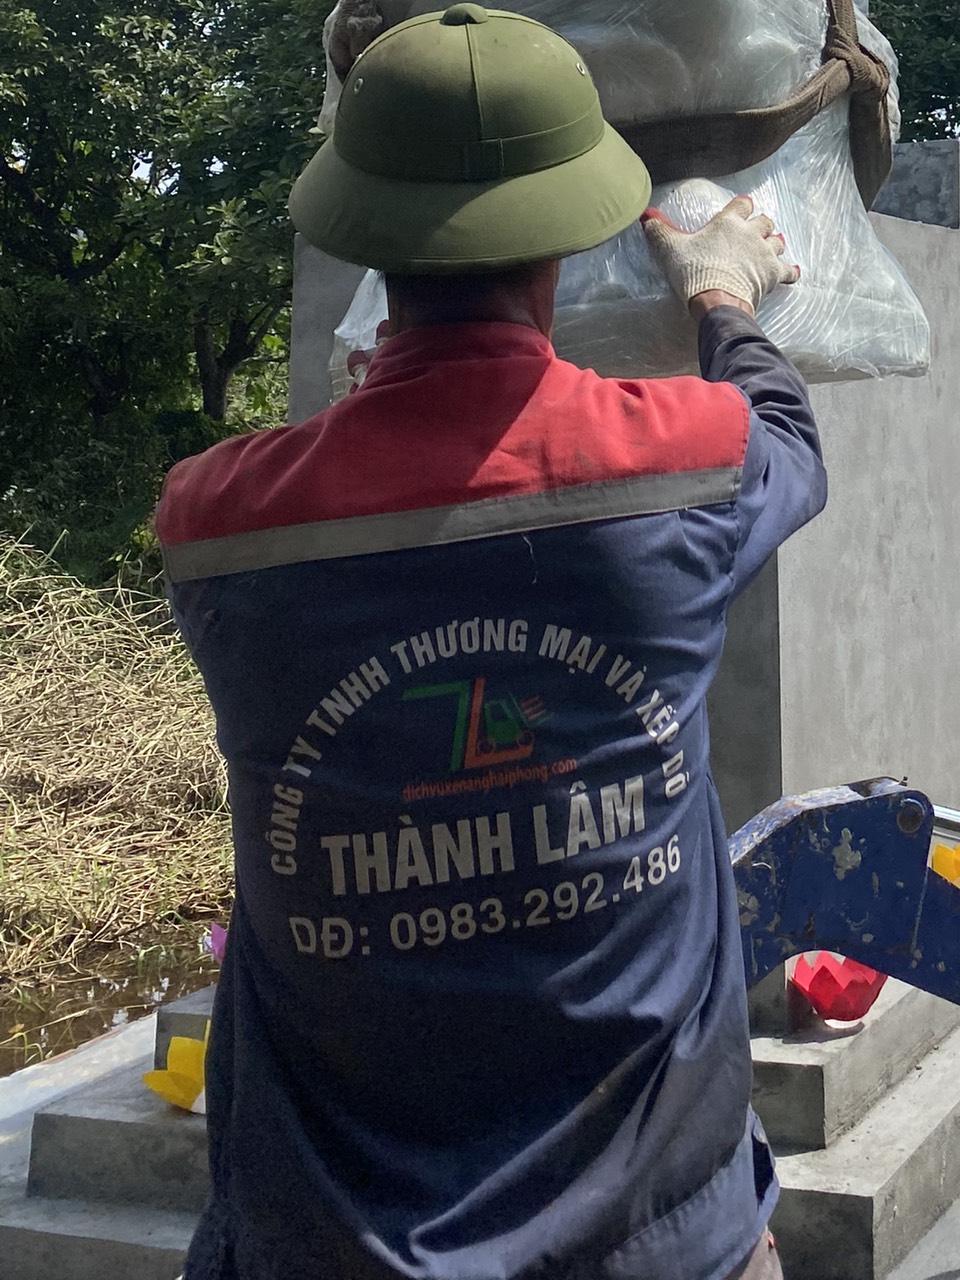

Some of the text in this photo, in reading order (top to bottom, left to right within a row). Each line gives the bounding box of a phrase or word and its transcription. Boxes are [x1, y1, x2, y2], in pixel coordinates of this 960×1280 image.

[390, 617, 529, 674] THƯƠNG
[538, 624, 607, 674] MẠI
[604, 654, 648, 703] VÀ
[305, 656, 391, 737] TNHH
[282, 735, 322, 778] TY
[265, 783, 304, 876] CÔNG
[320, 774, 646, 895] THÀNH LÂM
[390, 834, 681, 950] 0983.292.486
